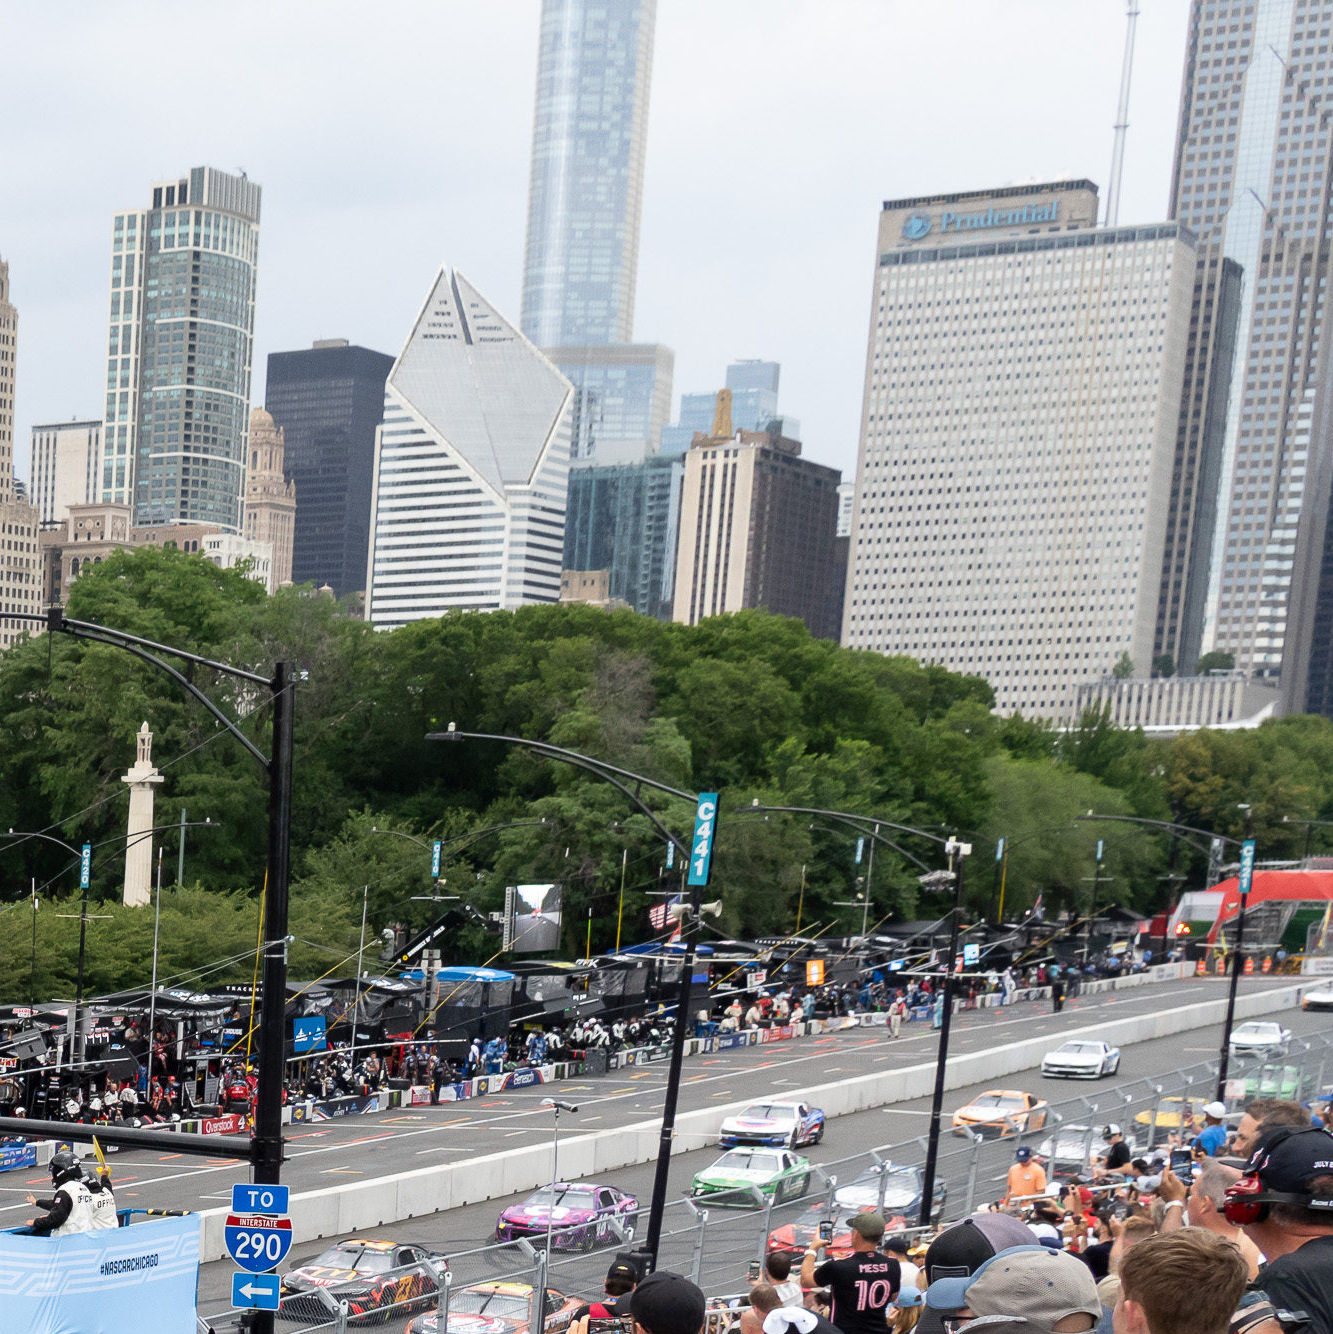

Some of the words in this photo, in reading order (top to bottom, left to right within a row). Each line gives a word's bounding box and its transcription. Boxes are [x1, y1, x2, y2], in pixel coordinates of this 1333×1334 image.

[941, 201, 1058, 232] Prudential
[694, 801, 715, 877] C441
[205, 1117, 234, 1134] Overstock
[247, 1191, 274, 1208] TO
[239, 1217, 278, 1228] INTERSTATE
[235, 1233, 281, 1260] 290
[100, 1253, 159, 1276] #NASCARCHICAGO
[859, 1263, 888, 1273] MESSI
[854, 1280, 891, 1311] 10
